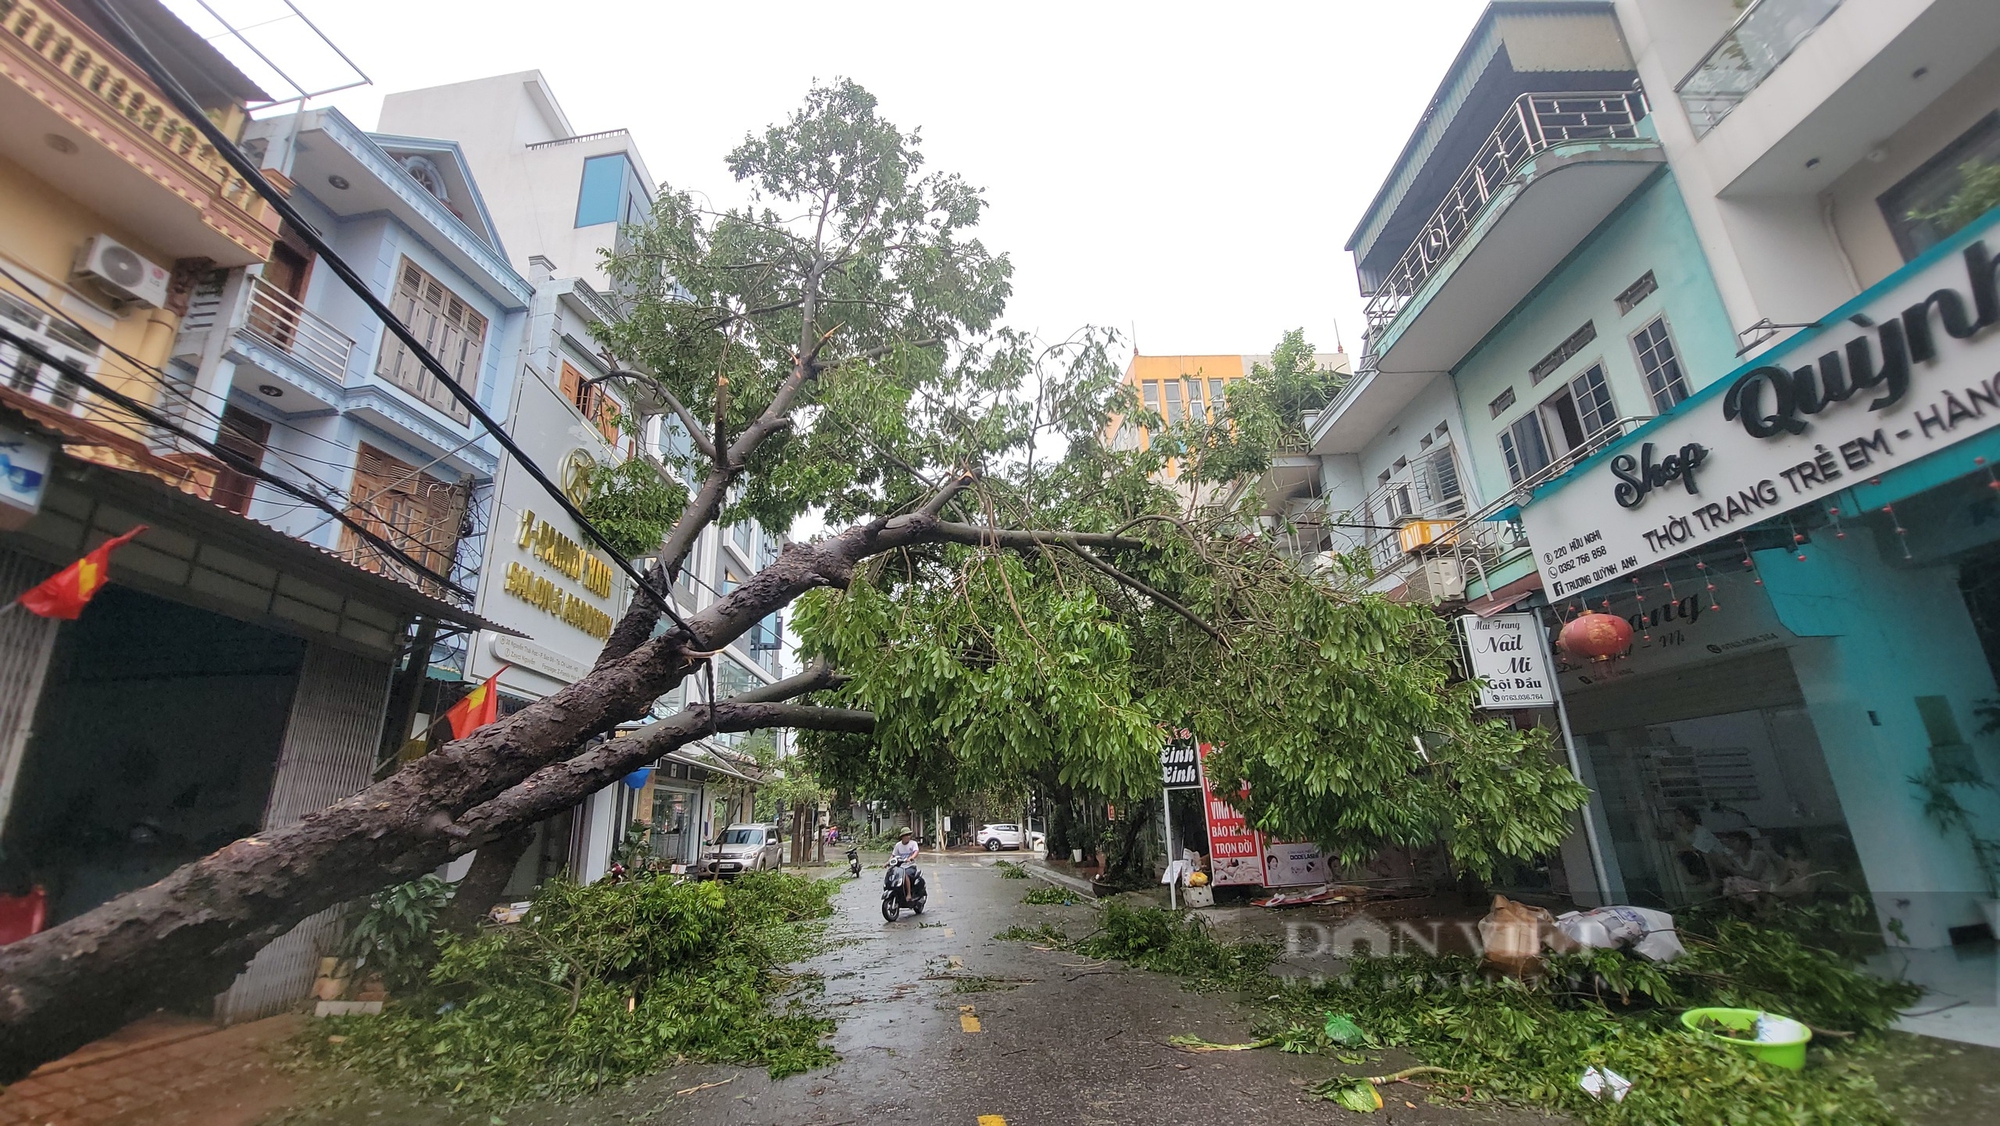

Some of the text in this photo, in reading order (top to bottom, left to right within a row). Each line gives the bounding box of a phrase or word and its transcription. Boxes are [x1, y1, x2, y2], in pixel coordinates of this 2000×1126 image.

[1610, 442, 1709, 508] Shop
[1642, 514, 1695, 553] THỜI
[1692, 479, 1779, 532] TRANG
[1779, 443, 1842, 494] TRẺ
[1838, 428, 1893, 471] EM
[1553, 545, 1568, 560] 220
[1583, 529, 1603, 545] NGHỊ
[1558, 545, 1607, 574] 0352 756 858
[1592, 563, 1618, 581] QUỲNH
[1621, 555, 1638, 570] ANH
[1473, 619, 1520, 631] Mai Trang
[1477, 633, 1523, 654] Nail
[1497, 656, 1533, 675] Mi
[1487, 678, 1511, 692] Gội
[1211, 821, 1253, 837] BẢO HN
[1215, 840, 1253, 858] TRỌN ĐỜI
